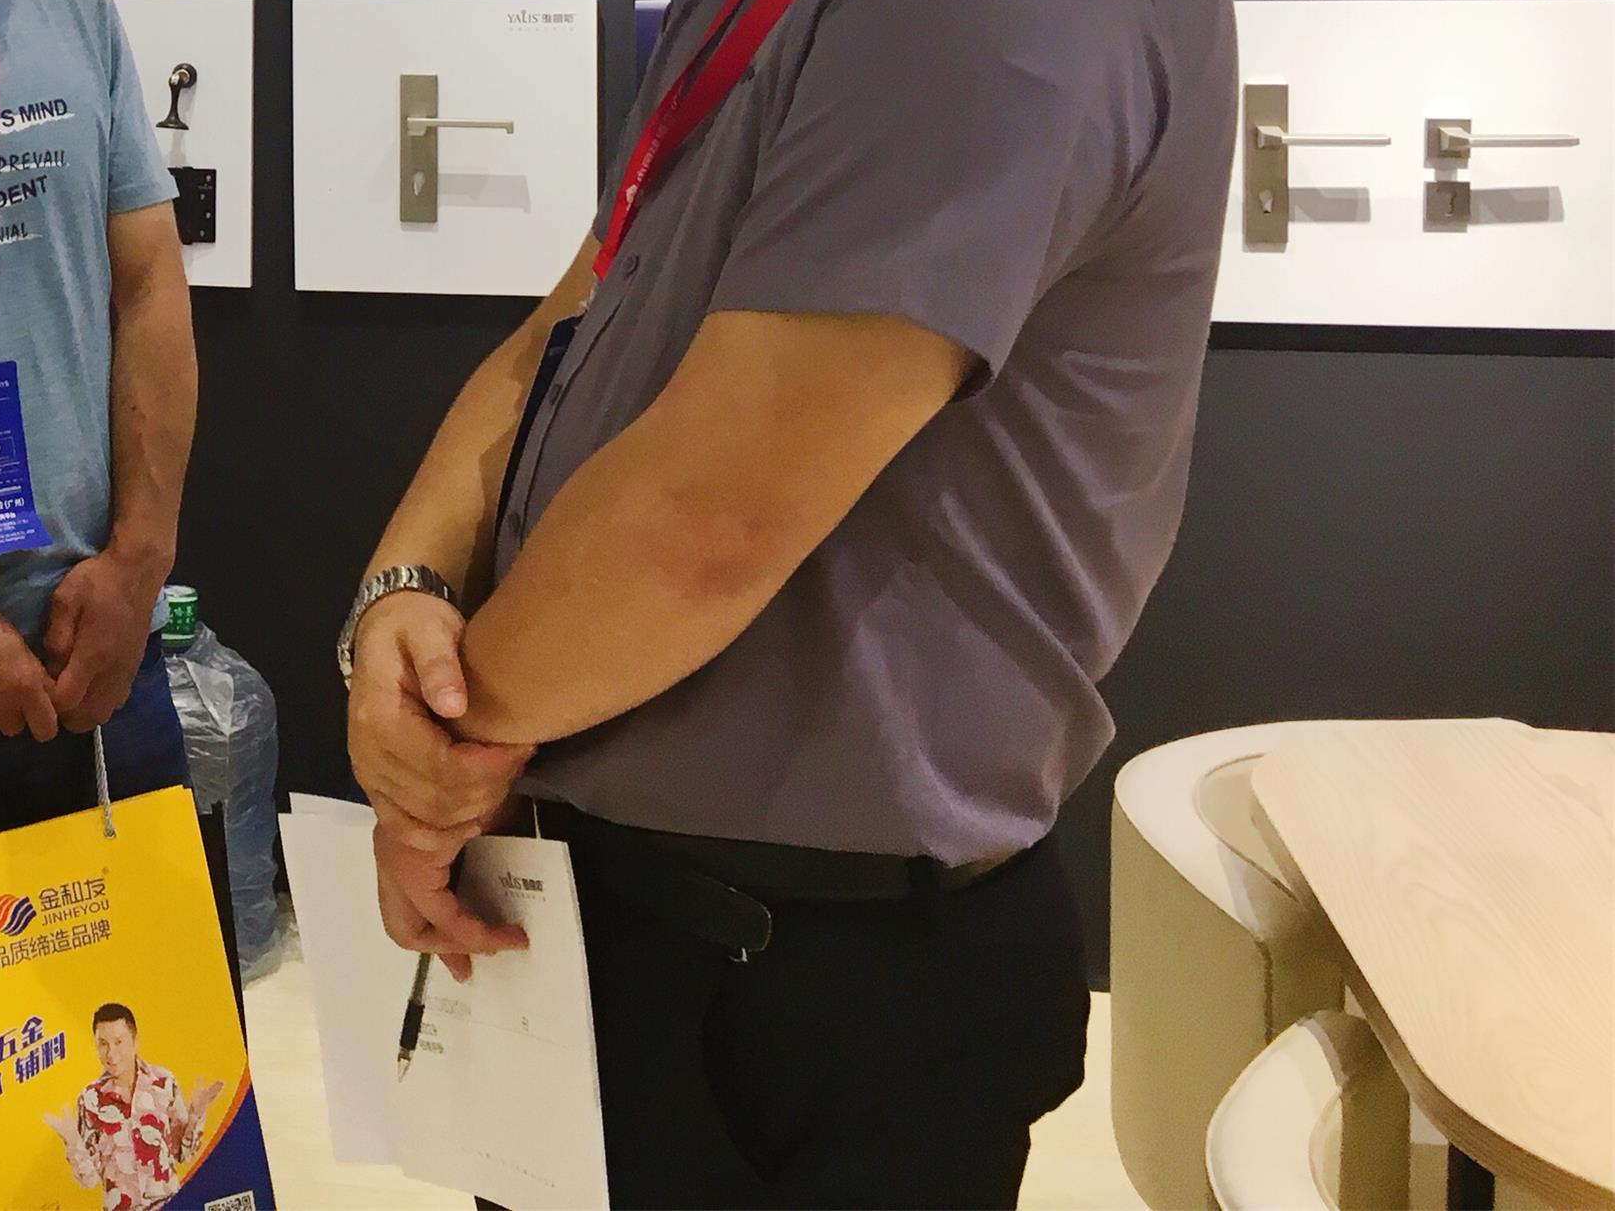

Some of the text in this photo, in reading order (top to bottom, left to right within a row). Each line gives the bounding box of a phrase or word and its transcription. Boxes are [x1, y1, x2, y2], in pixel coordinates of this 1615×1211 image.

[507, 9, 539, 24] YALIS
[19, 99, 68, 123] MIND
[39, 878, 106, 912] 金和友
[42, 899, 110, 926] JINHEYOU
[15, 1032, 65, 1084] 辅料
